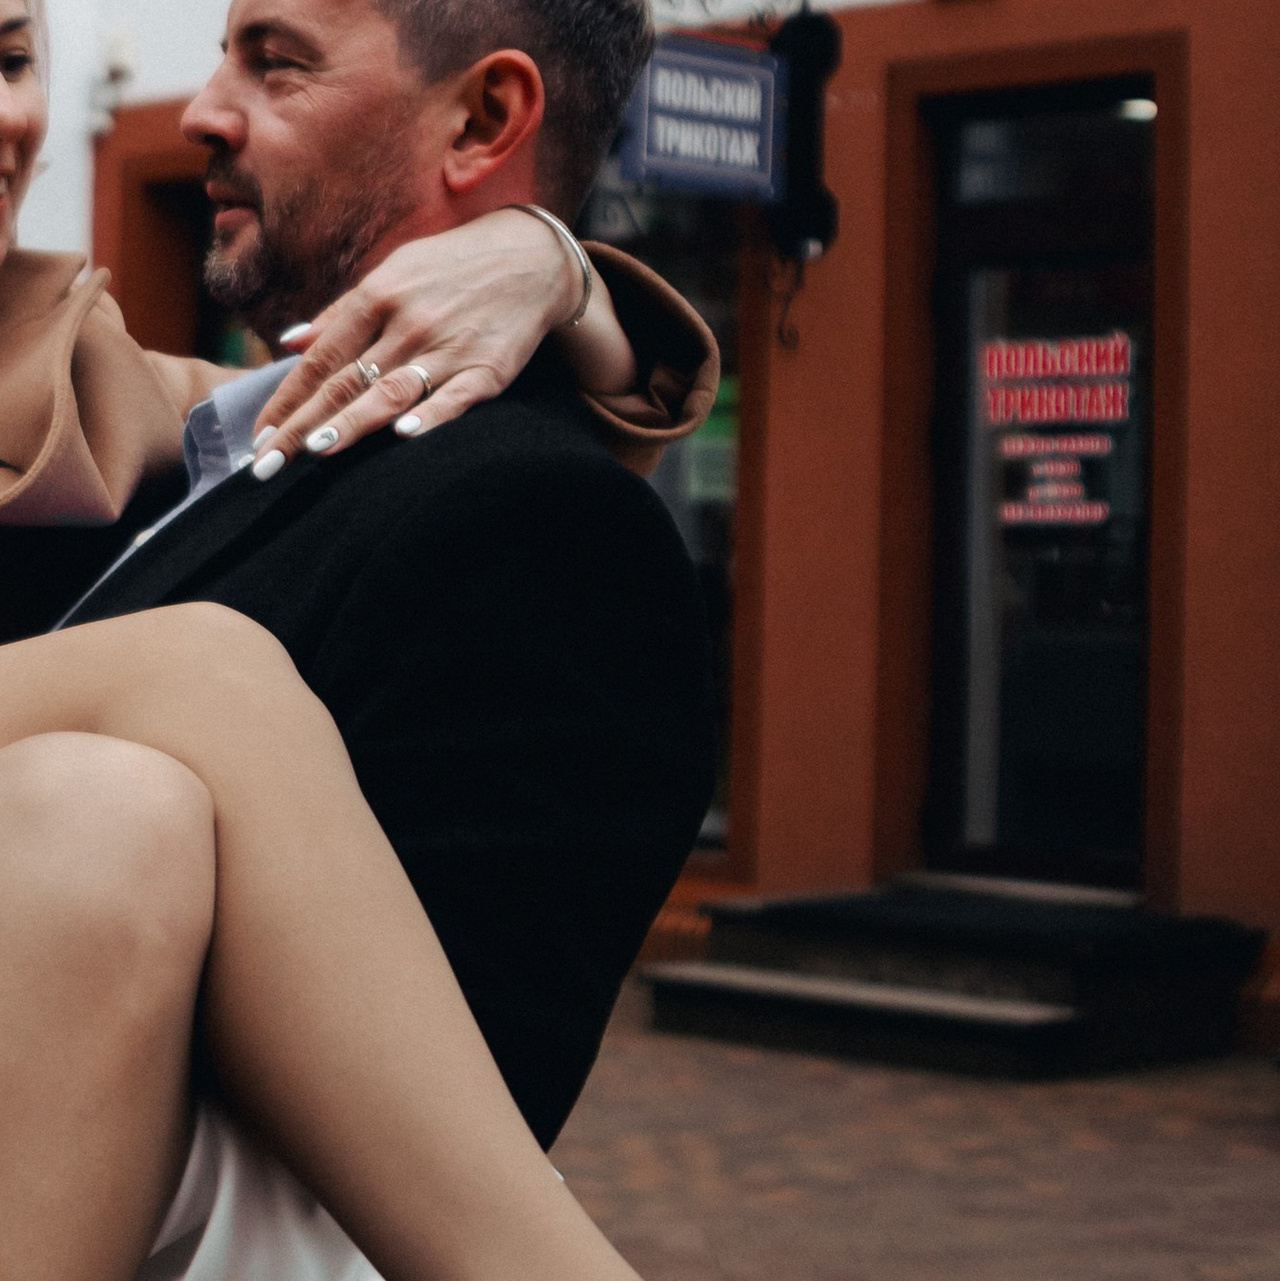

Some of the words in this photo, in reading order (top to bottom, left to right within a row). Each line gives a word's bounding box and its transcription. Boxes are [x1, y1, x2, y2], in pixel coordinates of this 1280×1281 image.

[655, 67, 762, 122] ПОЛЬСКИЙ
[654, 116, 760, 167] ТРИКОТАЖ
[985, 332, 1131, 378] ПОЛЬСКИЙ
[987, 383, 1129, 422] ТРИКОТАЖ
